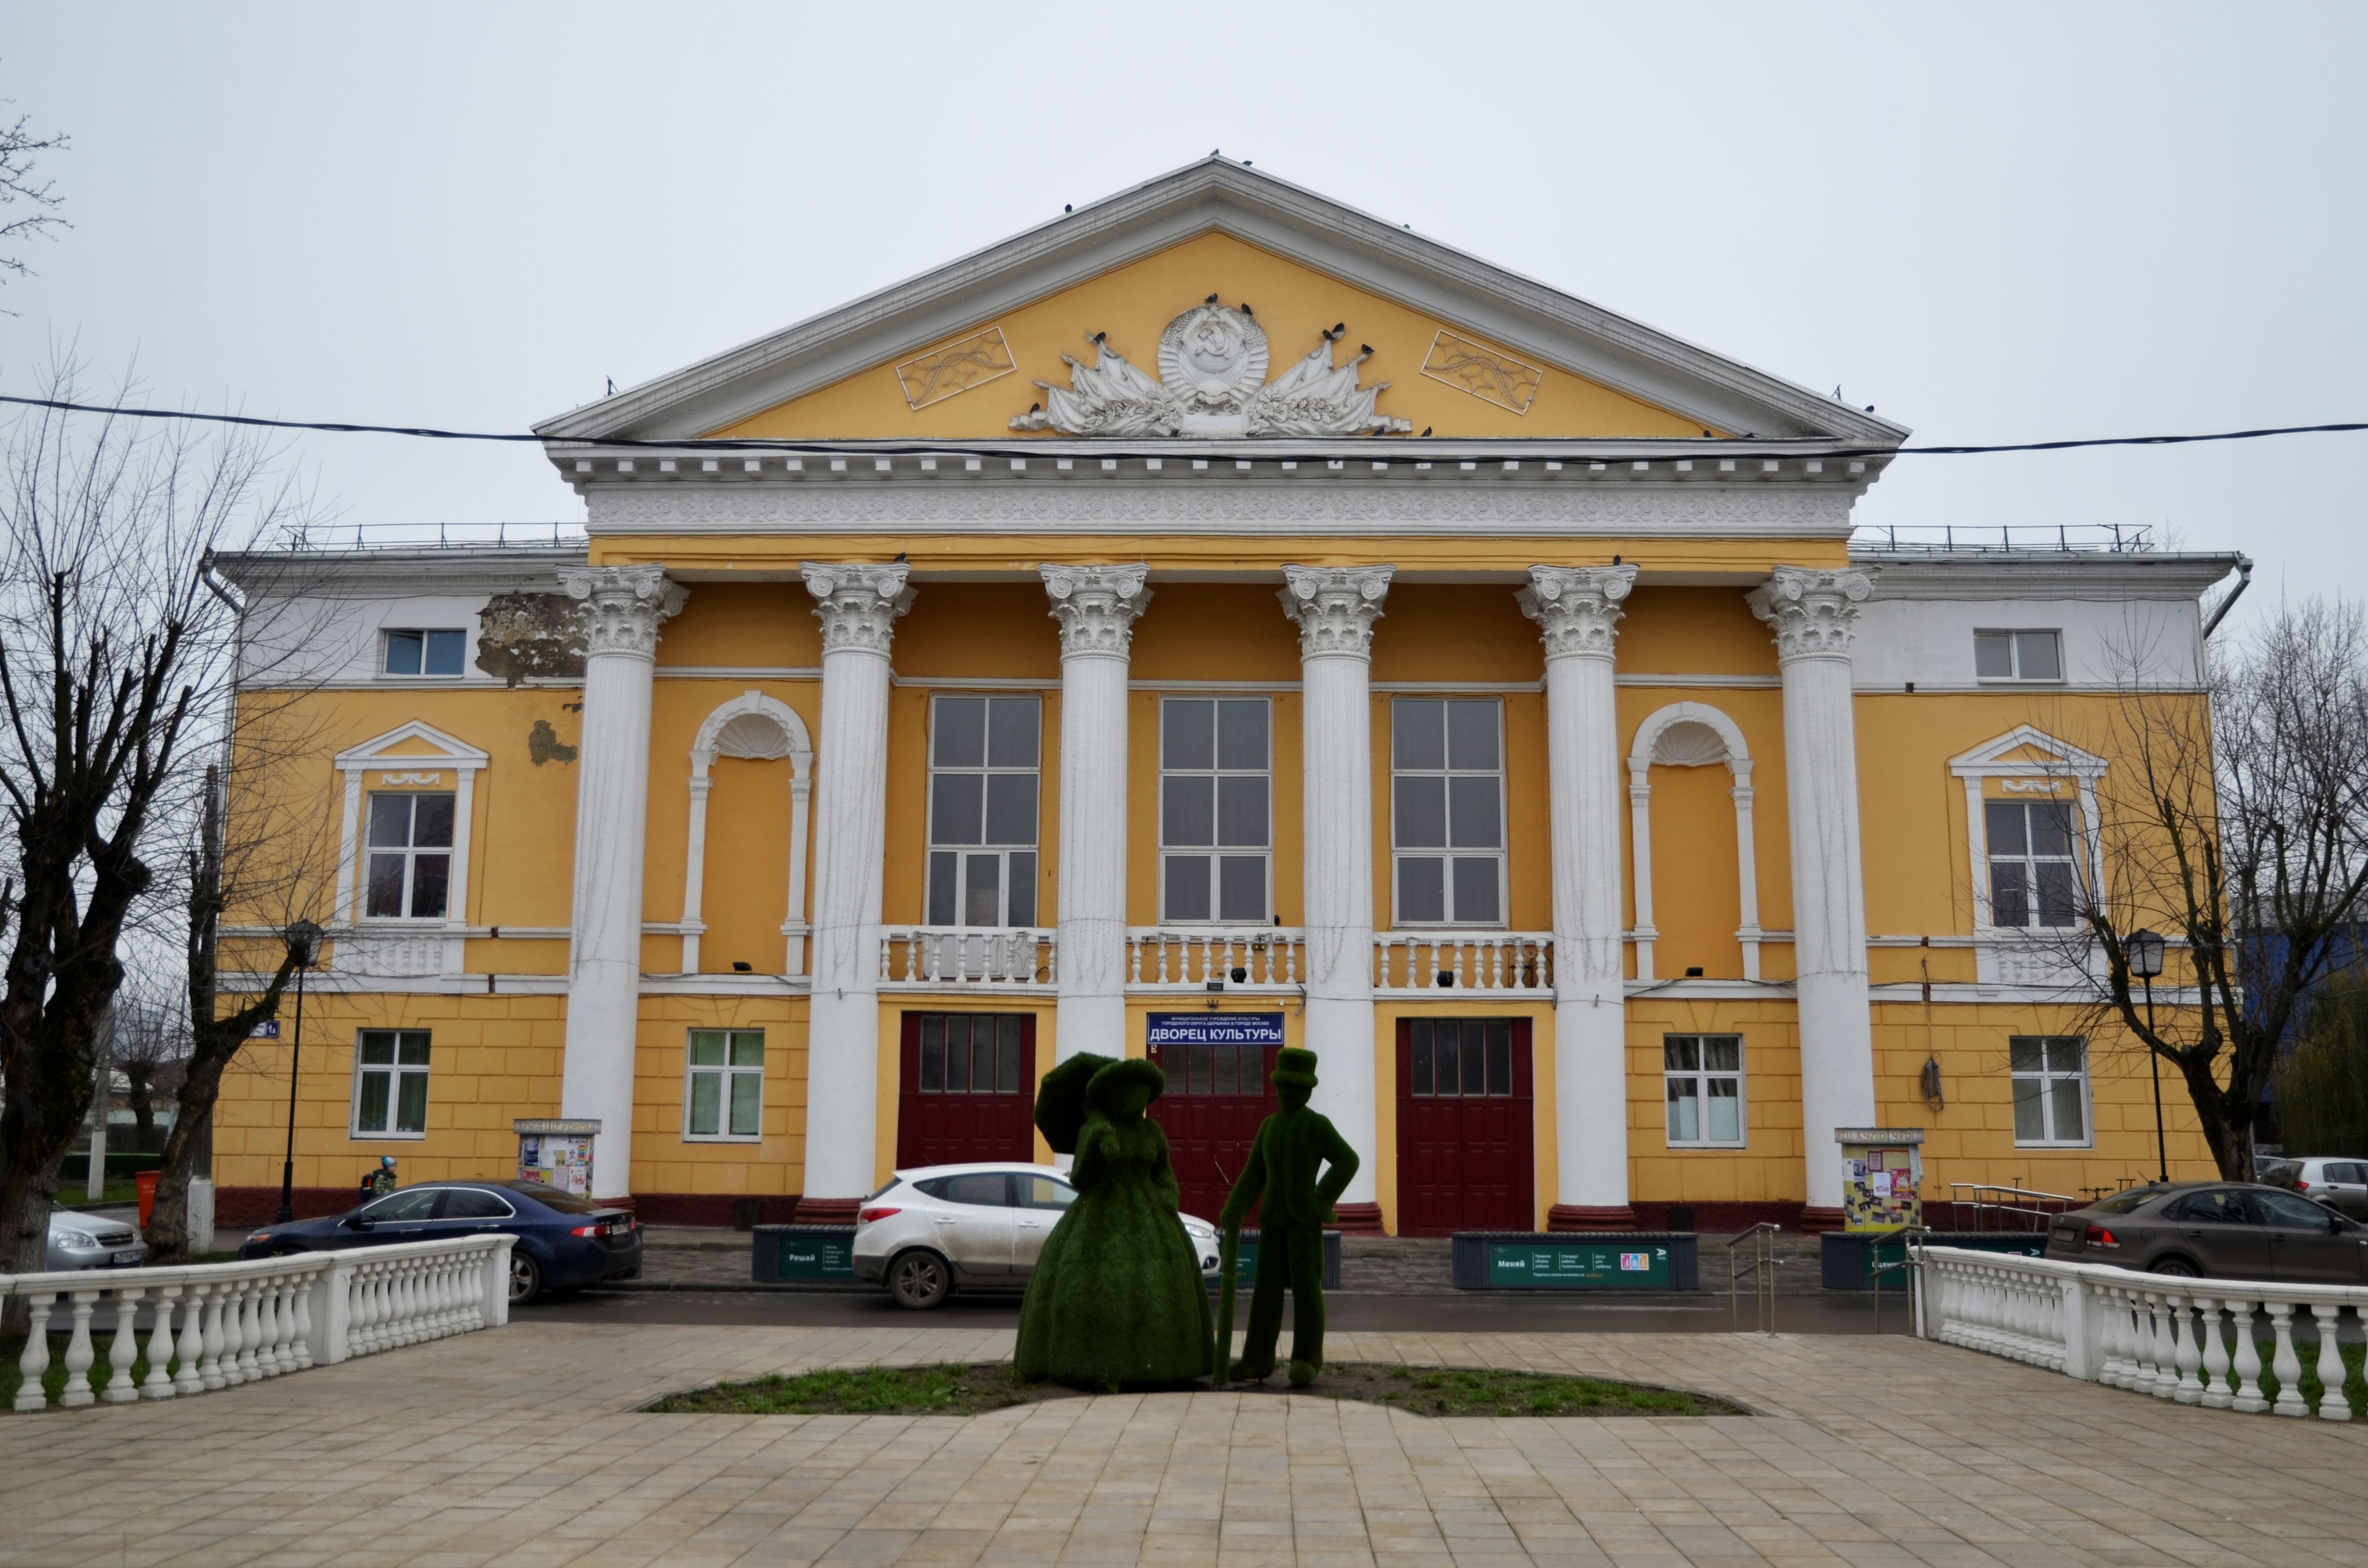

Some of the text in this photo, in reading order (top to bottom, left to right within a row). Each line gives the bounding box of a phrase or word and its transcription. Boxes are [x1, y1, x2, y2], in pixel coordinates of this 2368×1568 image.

[1150, 1029, 1281, 1041] ДВОРЕЦ КУЛЬТУРЫ
[1498, 1260, 1525, 1268] Меняй
